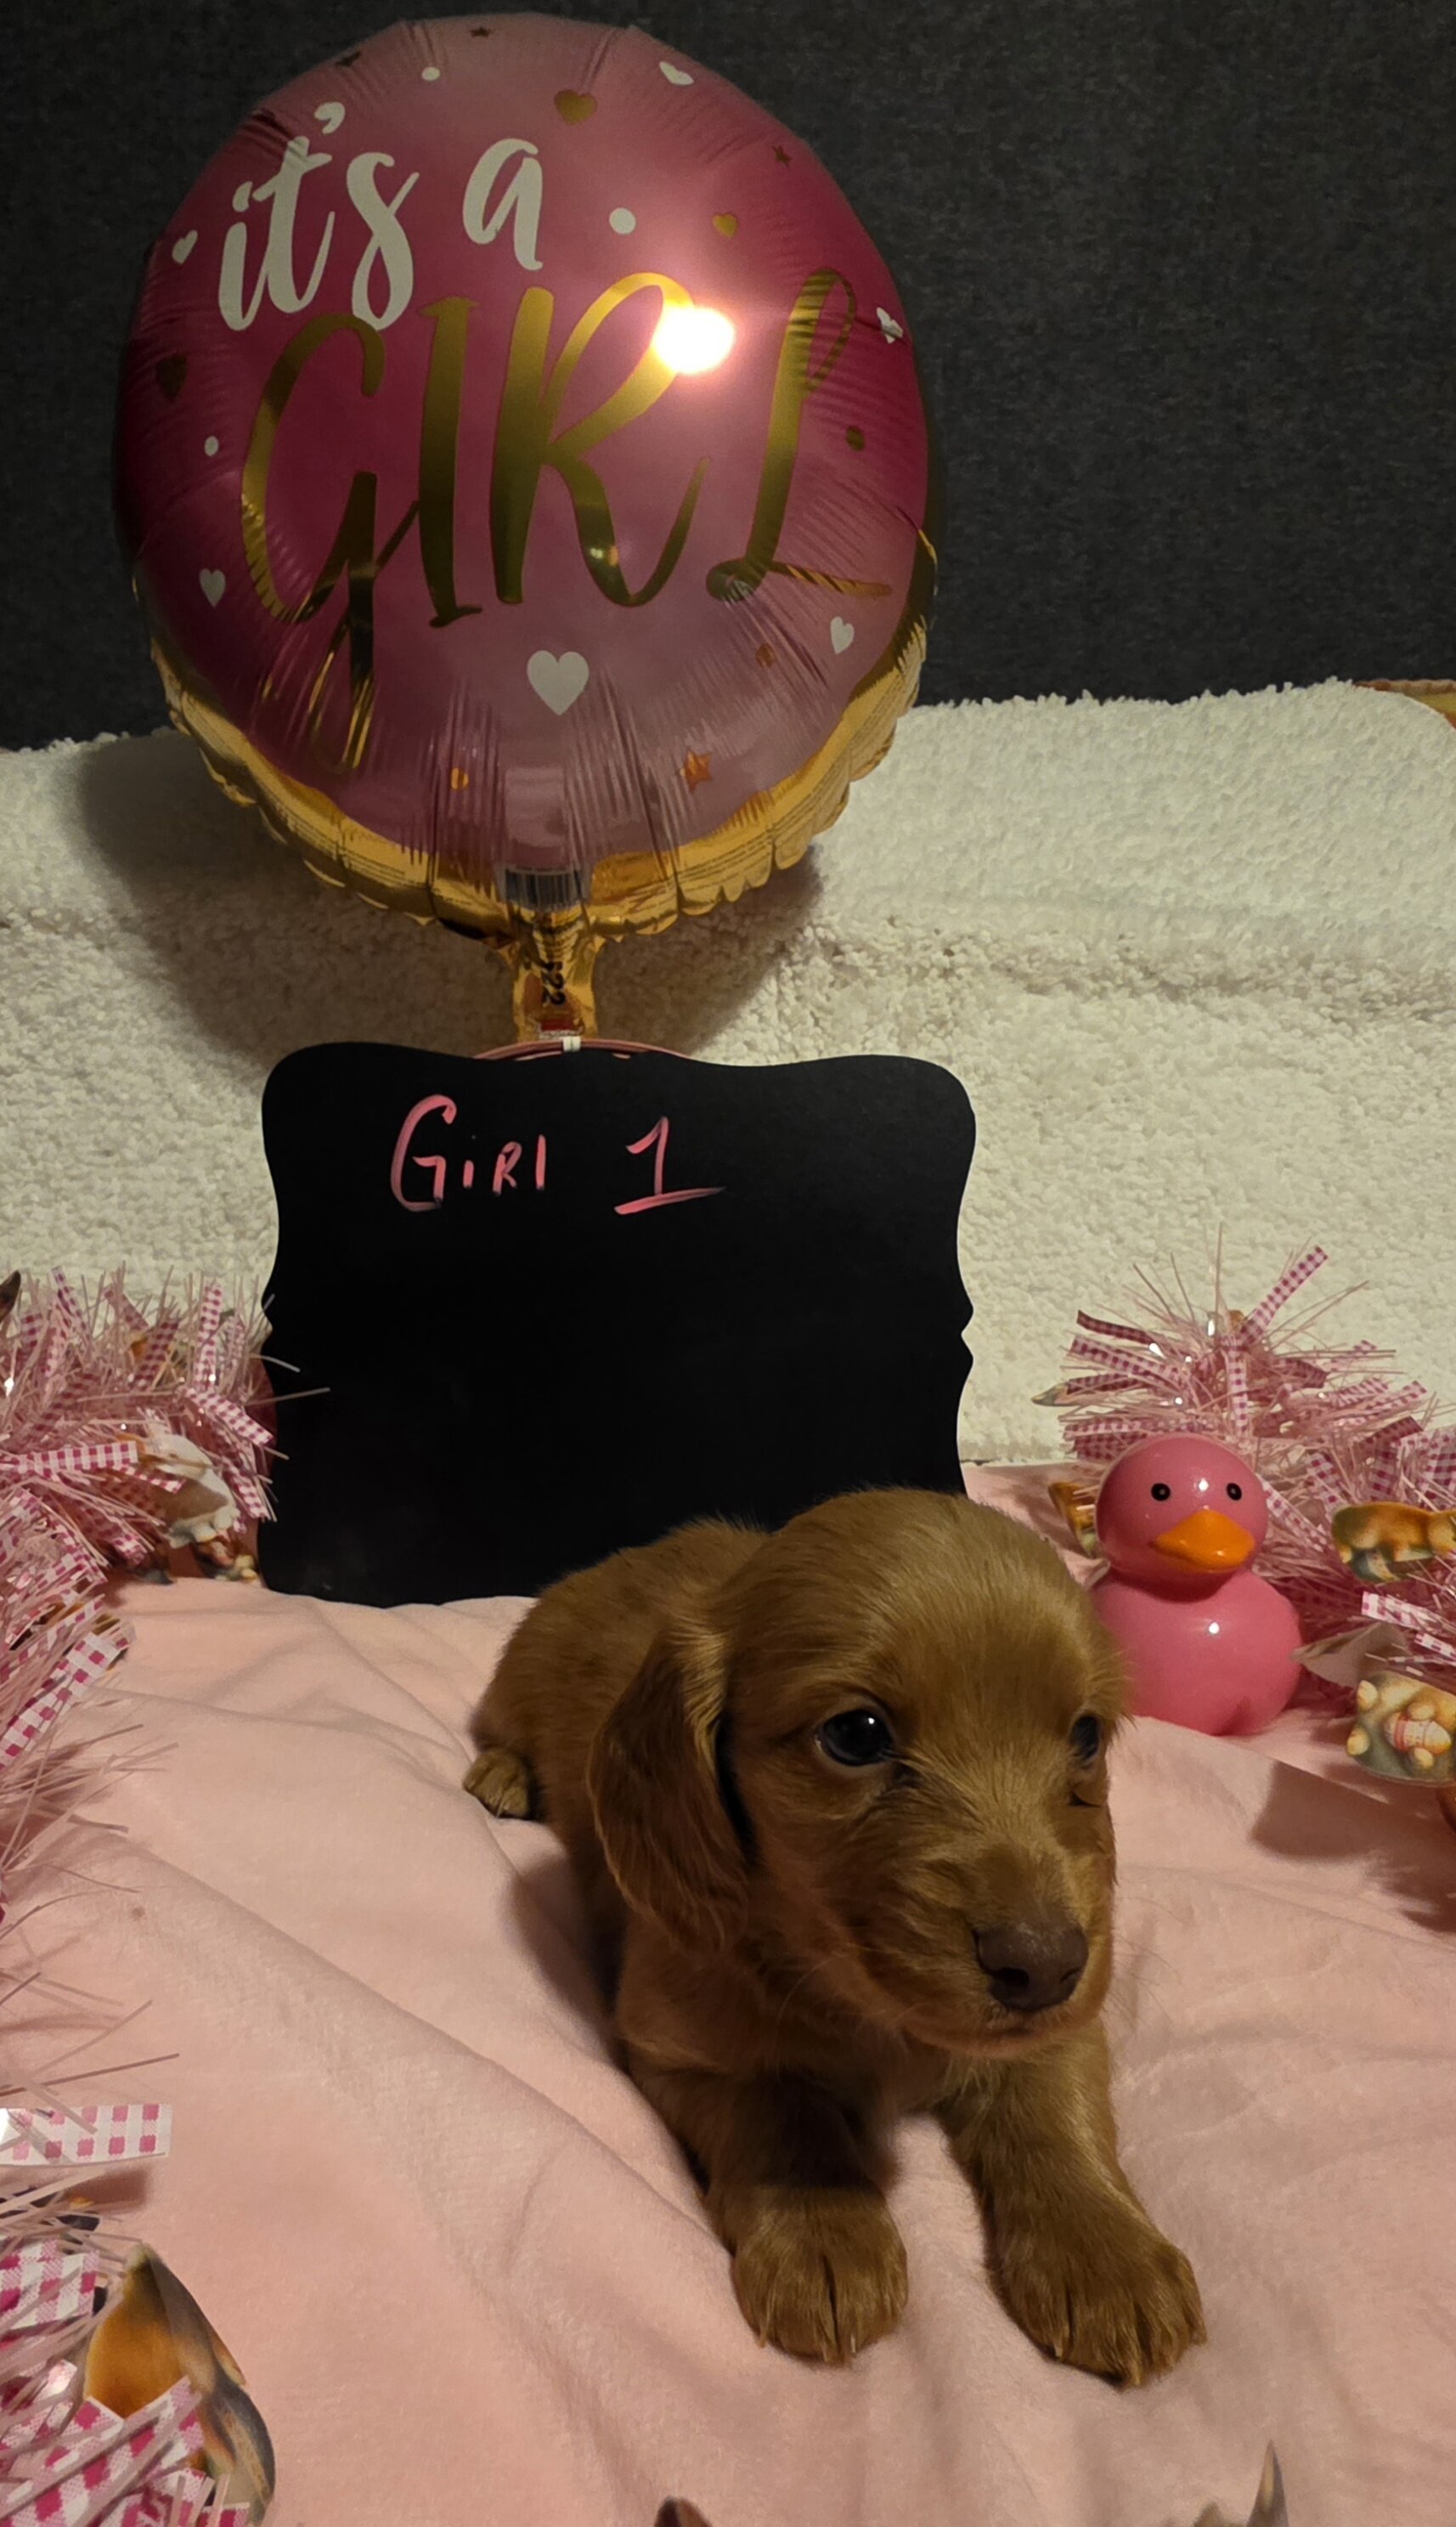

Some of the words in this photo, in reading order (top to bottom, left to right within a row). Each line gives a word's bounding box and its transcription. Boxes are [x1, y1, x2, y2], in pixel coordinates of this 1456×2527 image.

[217, 101, 420, 331] it's
[462, 138, 544, 271] a
[240, 266, 894, 770] GIRL
[614, 1115, 726, 1215] 1
